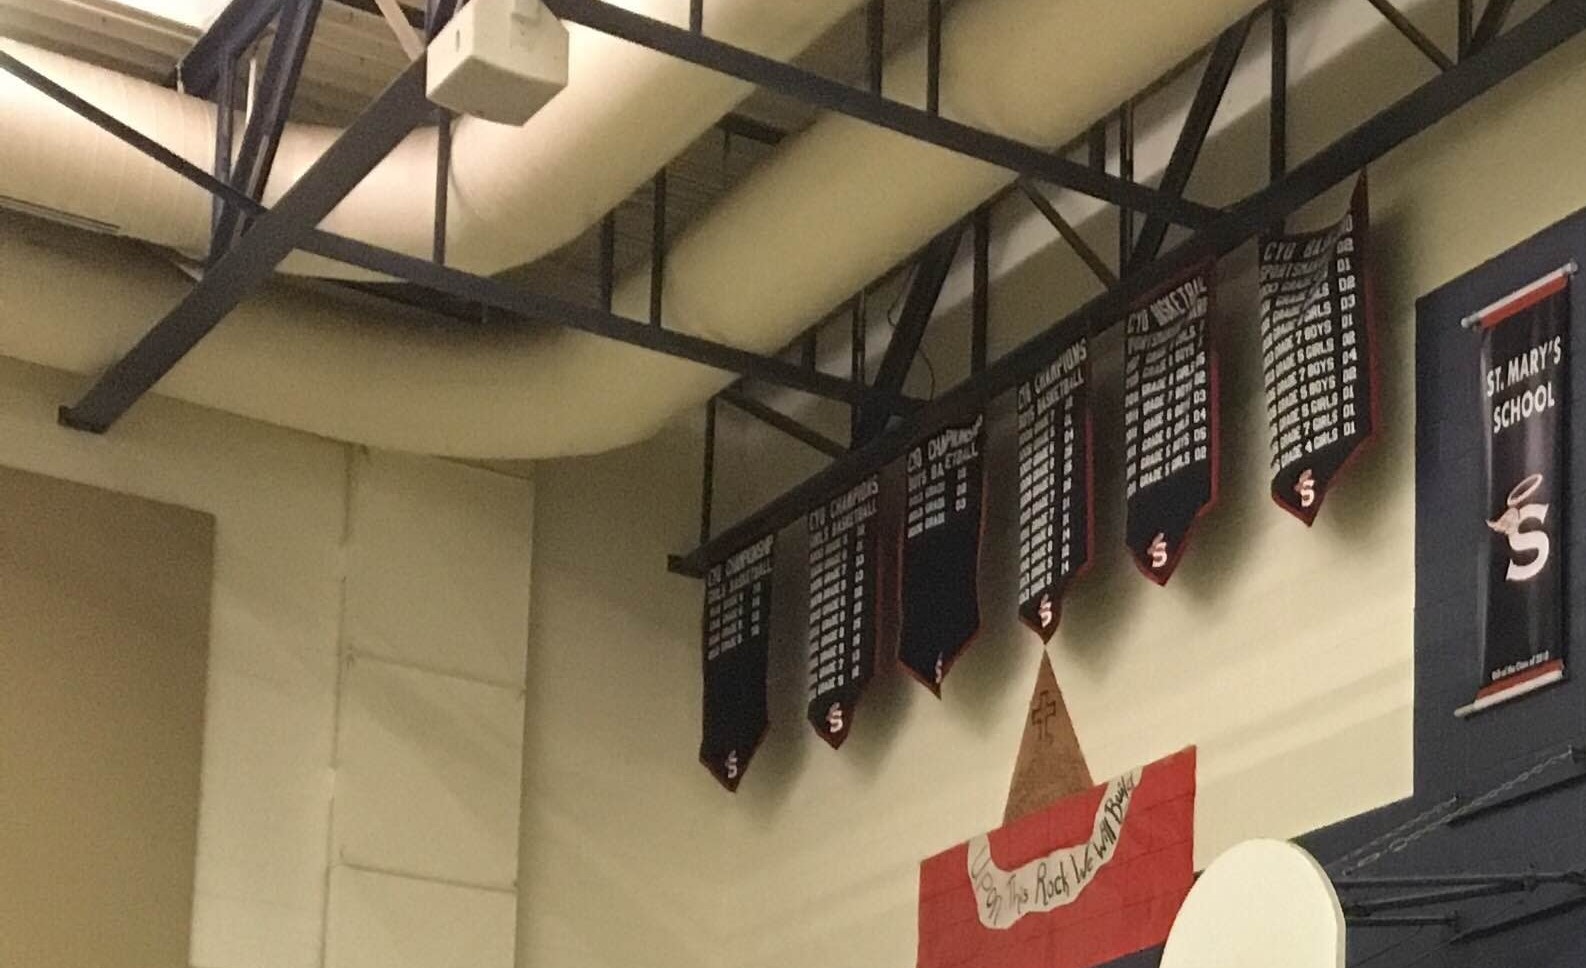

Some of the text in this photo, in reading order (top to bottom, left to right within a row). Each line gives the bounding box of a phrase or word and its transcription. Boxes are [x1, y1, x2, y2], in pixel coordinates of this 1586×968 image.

[1034, 337, 1087, 394] CHAMPIONS
[1486, 335, 1561, 397] ST. MARY'S
[1494, 381, 1555, 434] SCHOOL
[930, 441, 978, 480] BAETBALL
[1506, 503, 1550, 581] S
[971, 845, 1002, 926] Upon
[1008, 873, 1029, 914] This
[1035, 862, 1070, 906] Rock
